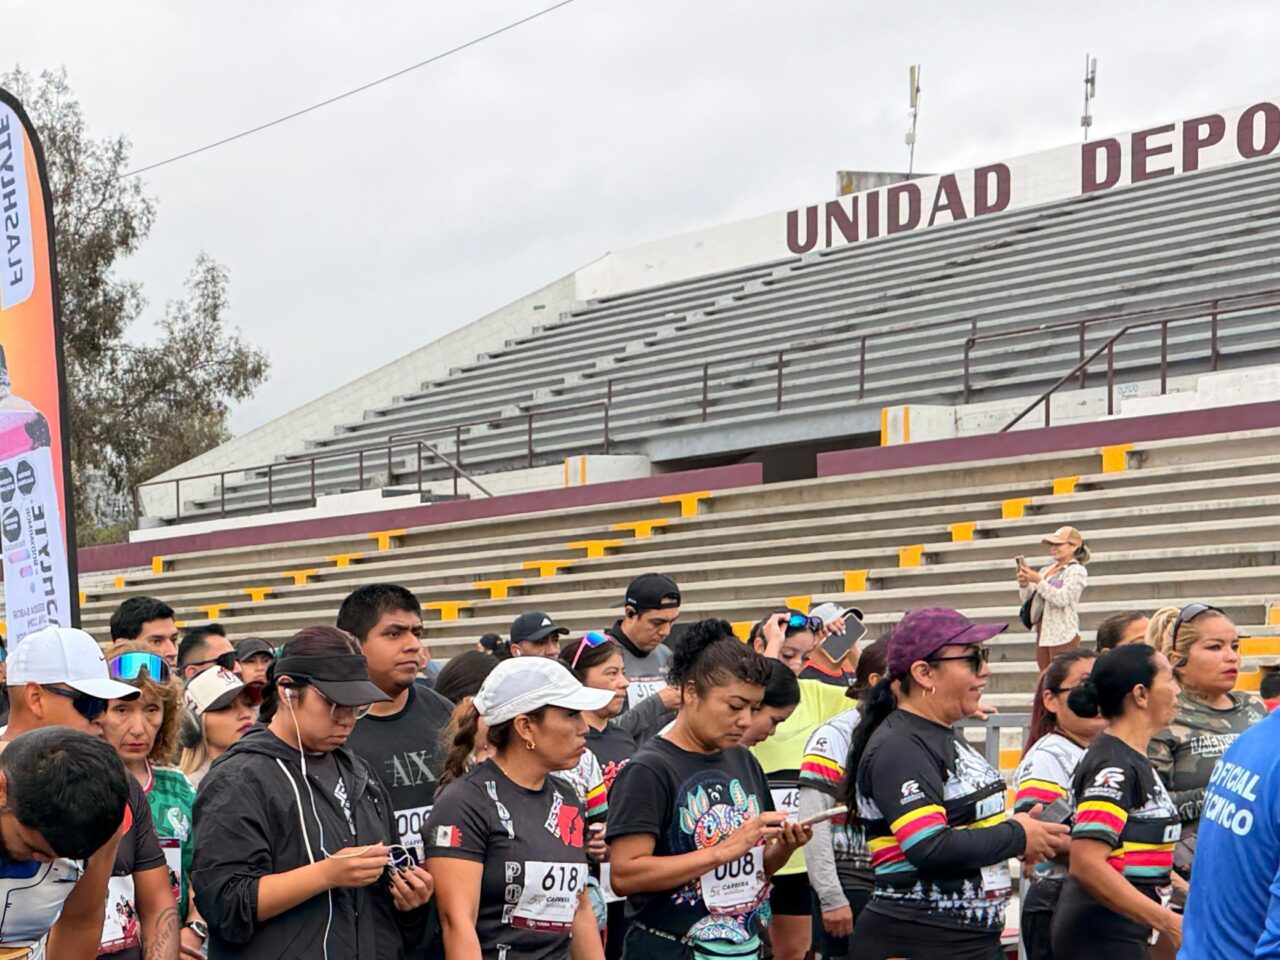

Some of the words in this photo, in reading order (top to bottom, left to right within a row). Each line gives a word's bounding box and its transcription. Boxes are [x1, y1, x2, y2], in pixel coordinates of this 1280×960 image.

[787, 162, 1011, 255] UNIDAD
[1082, 102, 1280, 195] DEPO
[542, 866, 579, 892] 618
